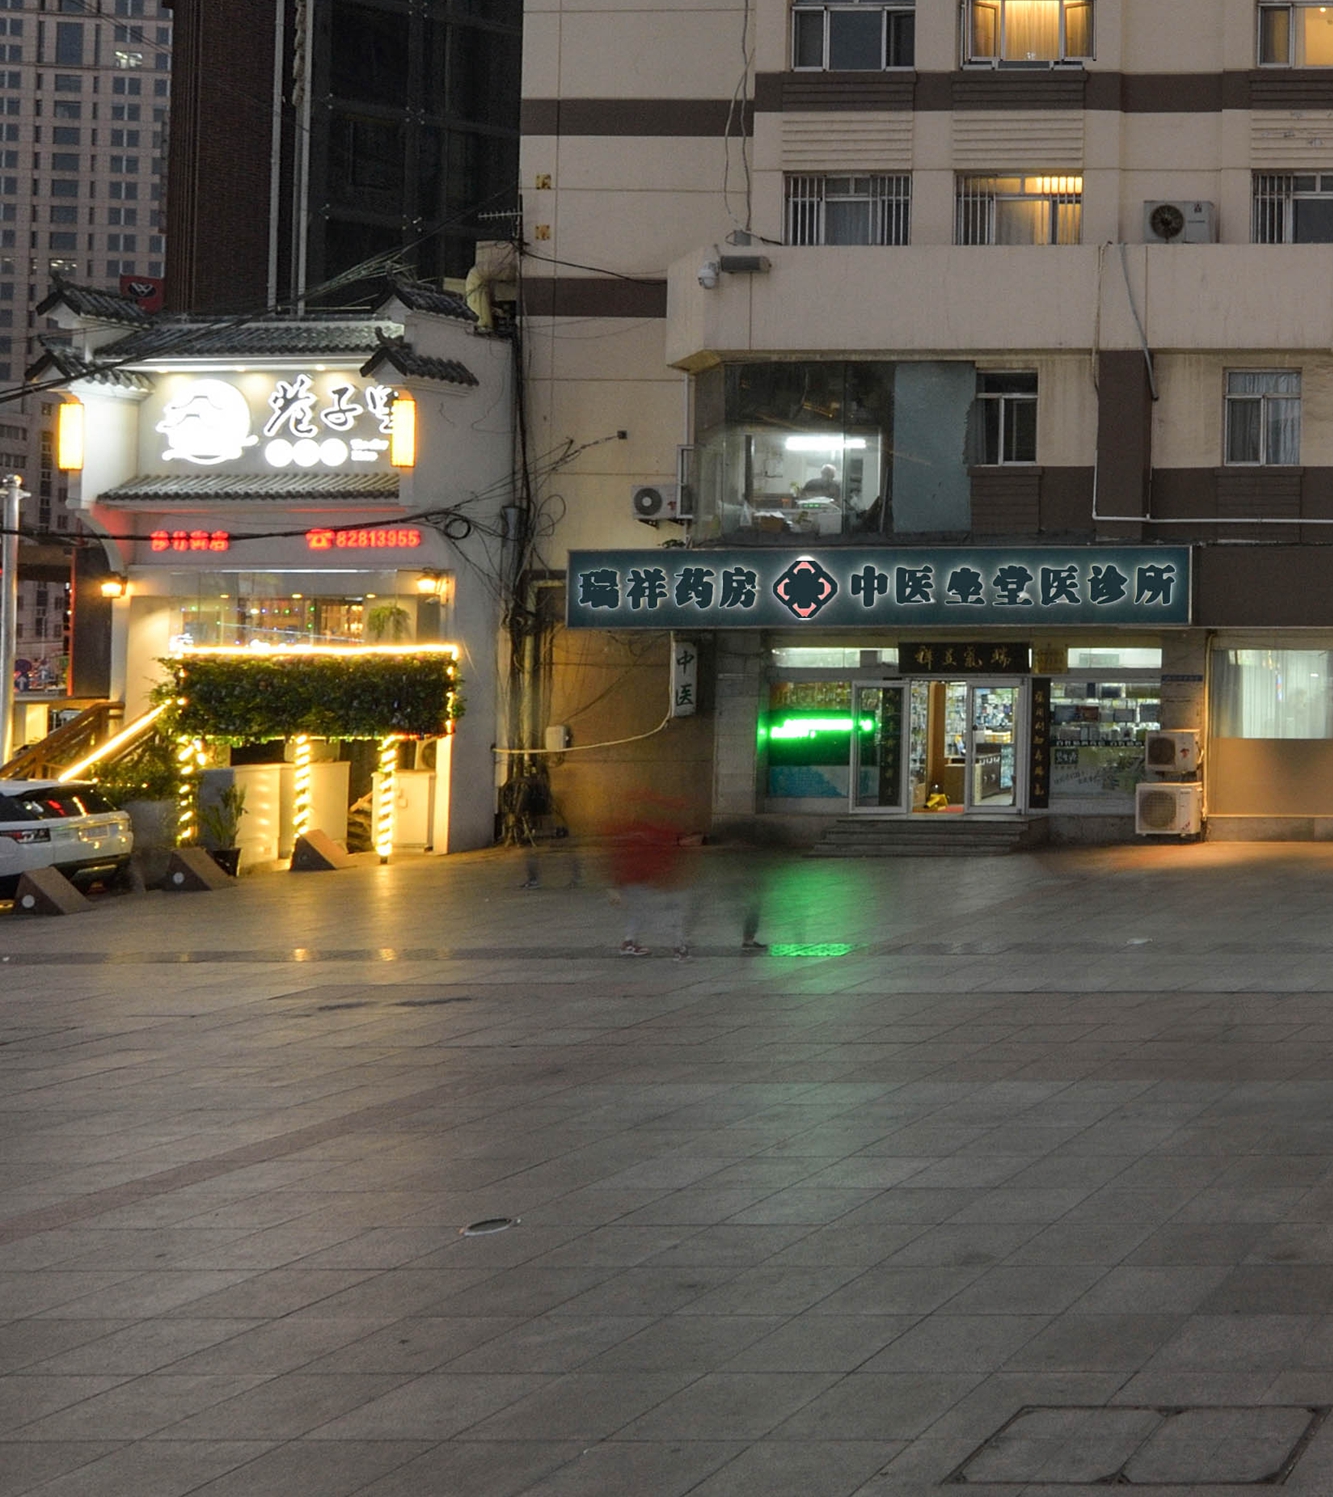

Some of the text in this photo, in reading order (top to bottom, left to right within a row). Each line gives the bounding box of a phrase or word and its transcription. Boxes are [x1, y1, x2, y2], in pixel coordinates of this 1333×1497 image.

[336, 529, 420, 548] 82813955
[579, 566, 759, 610] 瑞祥药房
[851, 564, 1176, 607] 中医坐堂医诊所
[676, 650, 694, 707] 中医
